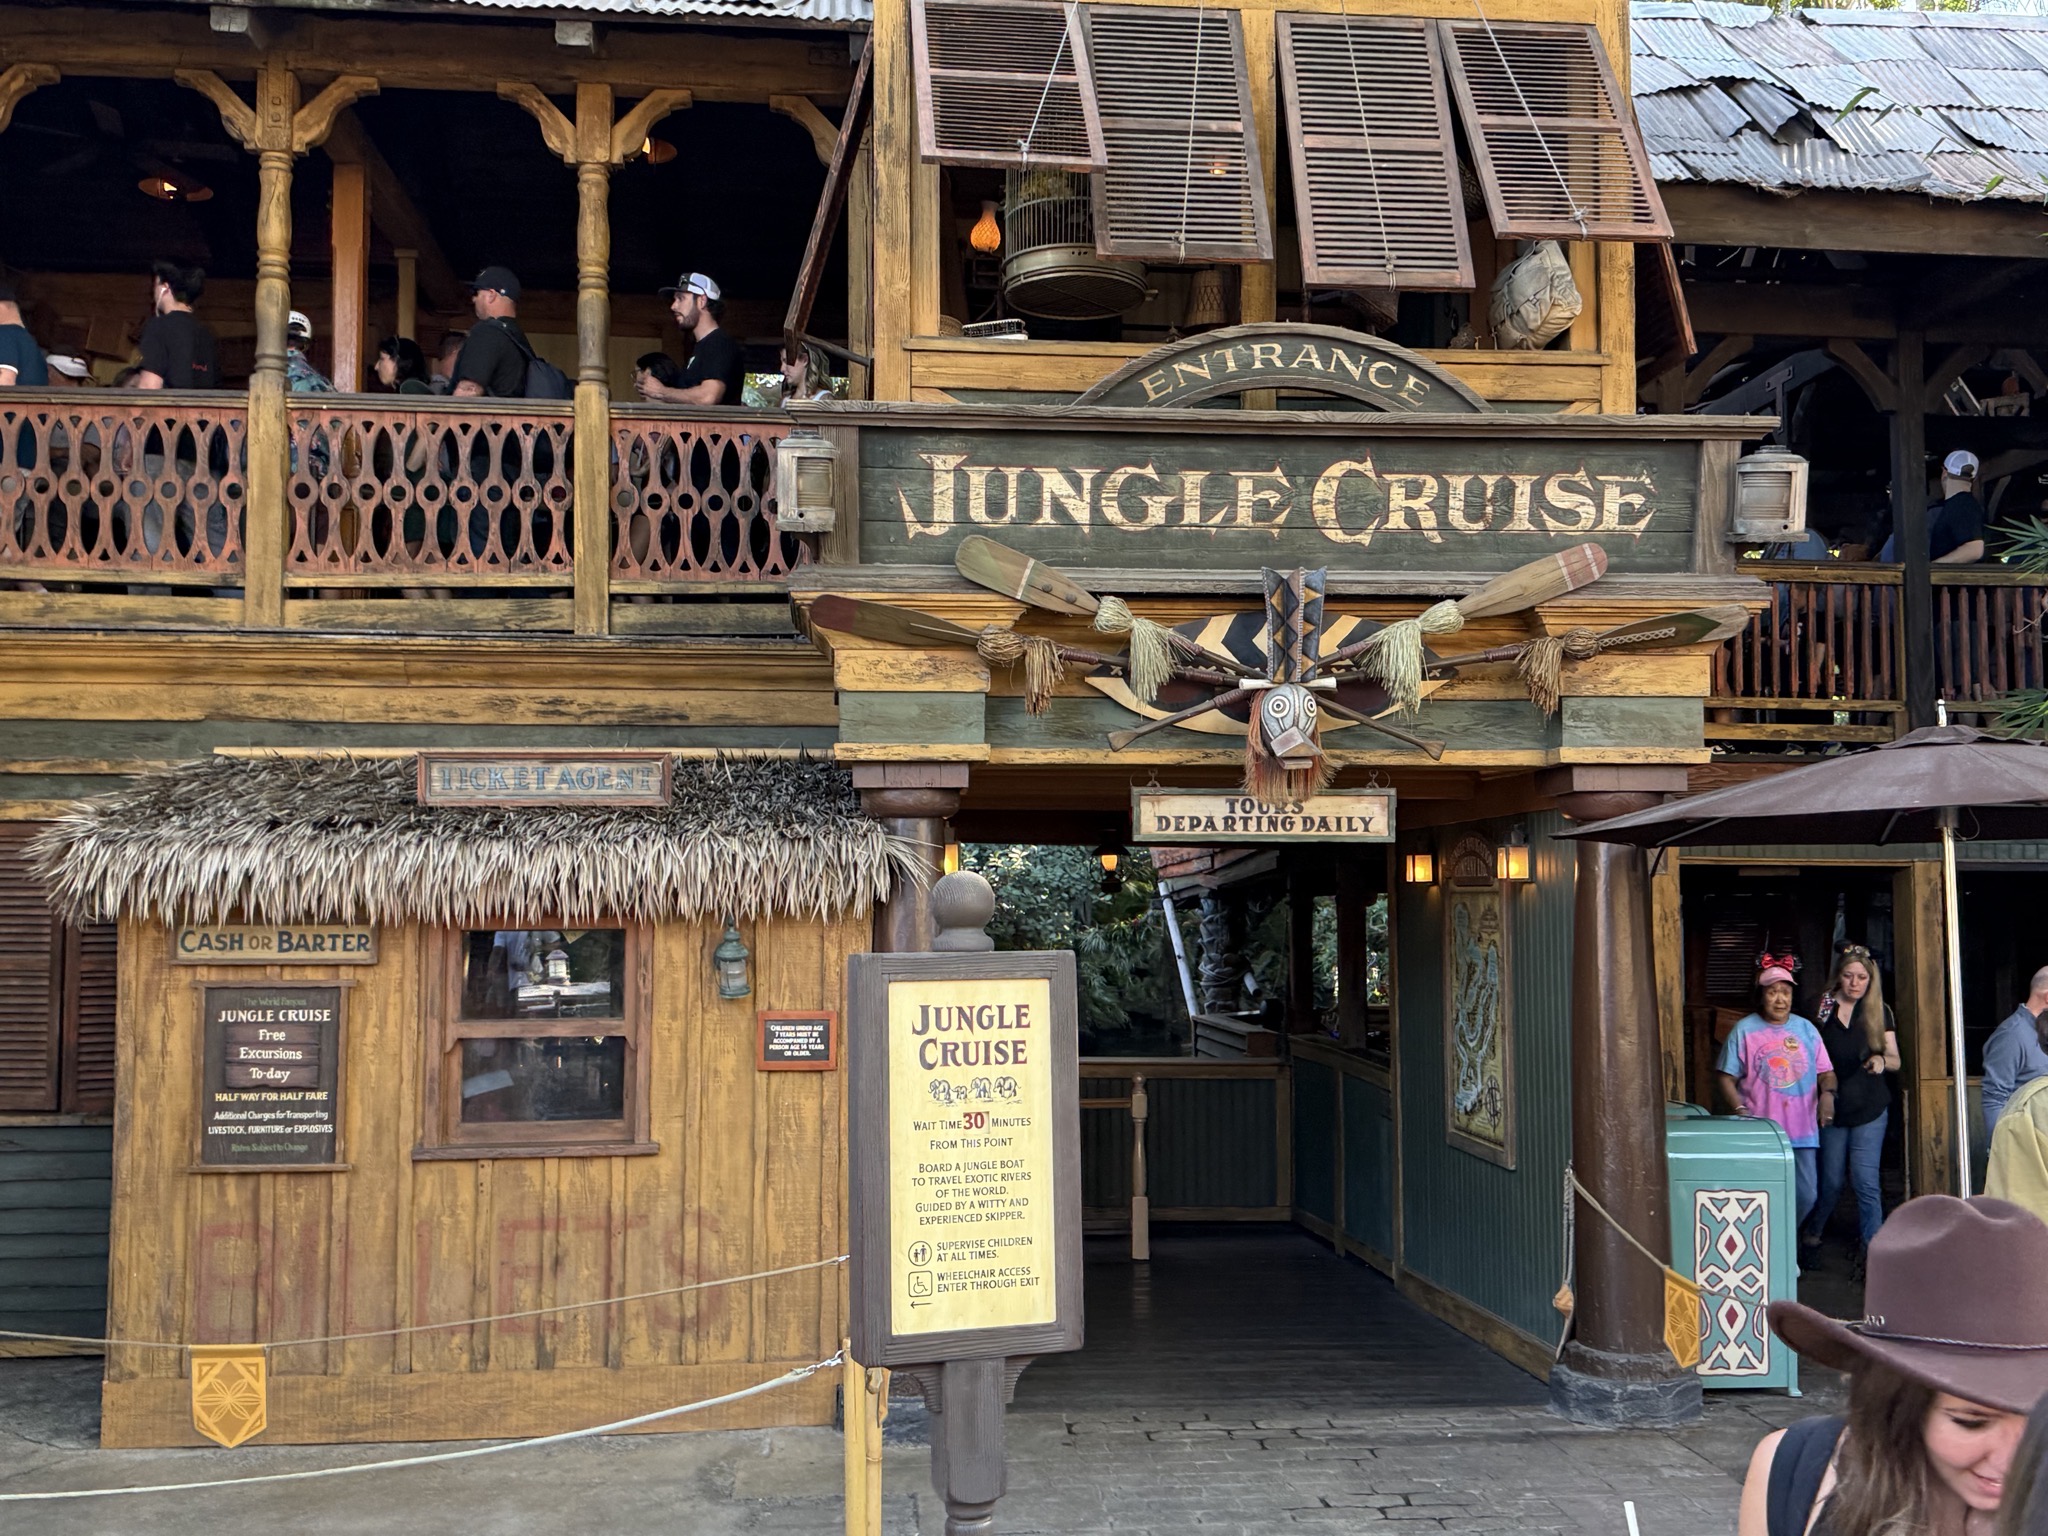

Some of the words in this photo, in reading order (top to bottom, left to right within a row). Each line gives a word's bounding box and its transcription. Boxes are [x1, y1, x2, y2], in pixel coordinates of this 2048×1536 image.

[1138, 343, 1430, 407] ENTRANCE
[898, 452, 1291, 540] JUNGLE
[1312, 455, 1658, 546] CRUISE
[440, 766, 550, 790] TICKET
[556, 766, 654, 790] AGENT
[1155, 816, 1296, 832] DEPARTING
[1301, 816, 1375, 832] DAILY
[180, 930, 244, 953] CASH
[250, 936, 273, 949] OR
[277, 931, 370, 953] BARTER
[218, 1010, 274, 1023] JUNGLE
[279, 1009, 331, 1021] CRUISE
[912, 1004, 1031, 1035] JUNGLE
[259, 1029, 286, 1040] Free
[240, 1047, 302, 1059] Excursions
[919, 1039, 1028, 1070] CRUISE
[250, 1067, 290, 1082] To-day
[215, 1093, 239, 1101] HALF
[240, 1093, 260, 1101] WAY
[261, 1092, 279, 1101] FOR
[280, 1092, 304, 1100] HALF
[305, 1092, 328, 1100] FARE
[214, 1111, 247, 1120] Additional
[248, 1111, 275, 1121] Charges
[276, 1110, 286, 1118] for
[286, 1110, 328, 1120] Transporting
[913, 1121, 937, 1130] WAIT
[940, 1120, 962, 1129] TIME
[963, 1112, 984, 1130] 30
[992, 1118, 1031, 1127] MINUTES
[294, 1124, 333, 1133] EXPLOSIVES
[930, 1140, 958, 1150] FROM
[961, 1139, 981, 1148] THIS
[984, 1138, 1013, 1147] POINT
[919, 1163, 952, 1173] BOARD
[955, 1162, 961, 1171] A
[963, 1161, 997, 1173] JUNGLE
[1000, 1160, 1025, 1169] BOAT
[912, 1177, 925, 1187] TO
[929, 1176, 962, 1185] TRAVEL
[965, 1174, 998, 1183] EXOTIC
[1001, 1172, 1031, 1181] RIVERS
[936, 1189, 949, 1198] OF
[952, 1188, 970, 1197] THE
[973, 1186, 1008, 1196] WORLD.
[916, 1202, 952, 1212] GUIDED
[955, 1201, 967, 1210] BY
[969, 1201, 975, 1209] A
[978, 1199, 1007, 1209] WITTY
[1009, 1198, 1029, 1206] AND
[920, 1214, 982, 1225] EXPERIENCED
[985, 1211, 1025, 1221] SKIPPER.
[937, 1240, 985, 1251] SUPERVISE
[988, 1237, 1032, 1247] CHILDREN
[937, 1253, 948, 1262] AT
[951, 1252, 966, 1261] ALL
[969, 1250, 999, 1260] TIMES.
[937, 1269, 996, 1281] WHEELCHAIR
[998, 1266, 1031, 1277] ACCESS
[938, 1282, 968, 1292] ENTER
[970, 1278, 1017, 1290] THROUGH
[1020, 1277, 1040, 1286] EXIT
